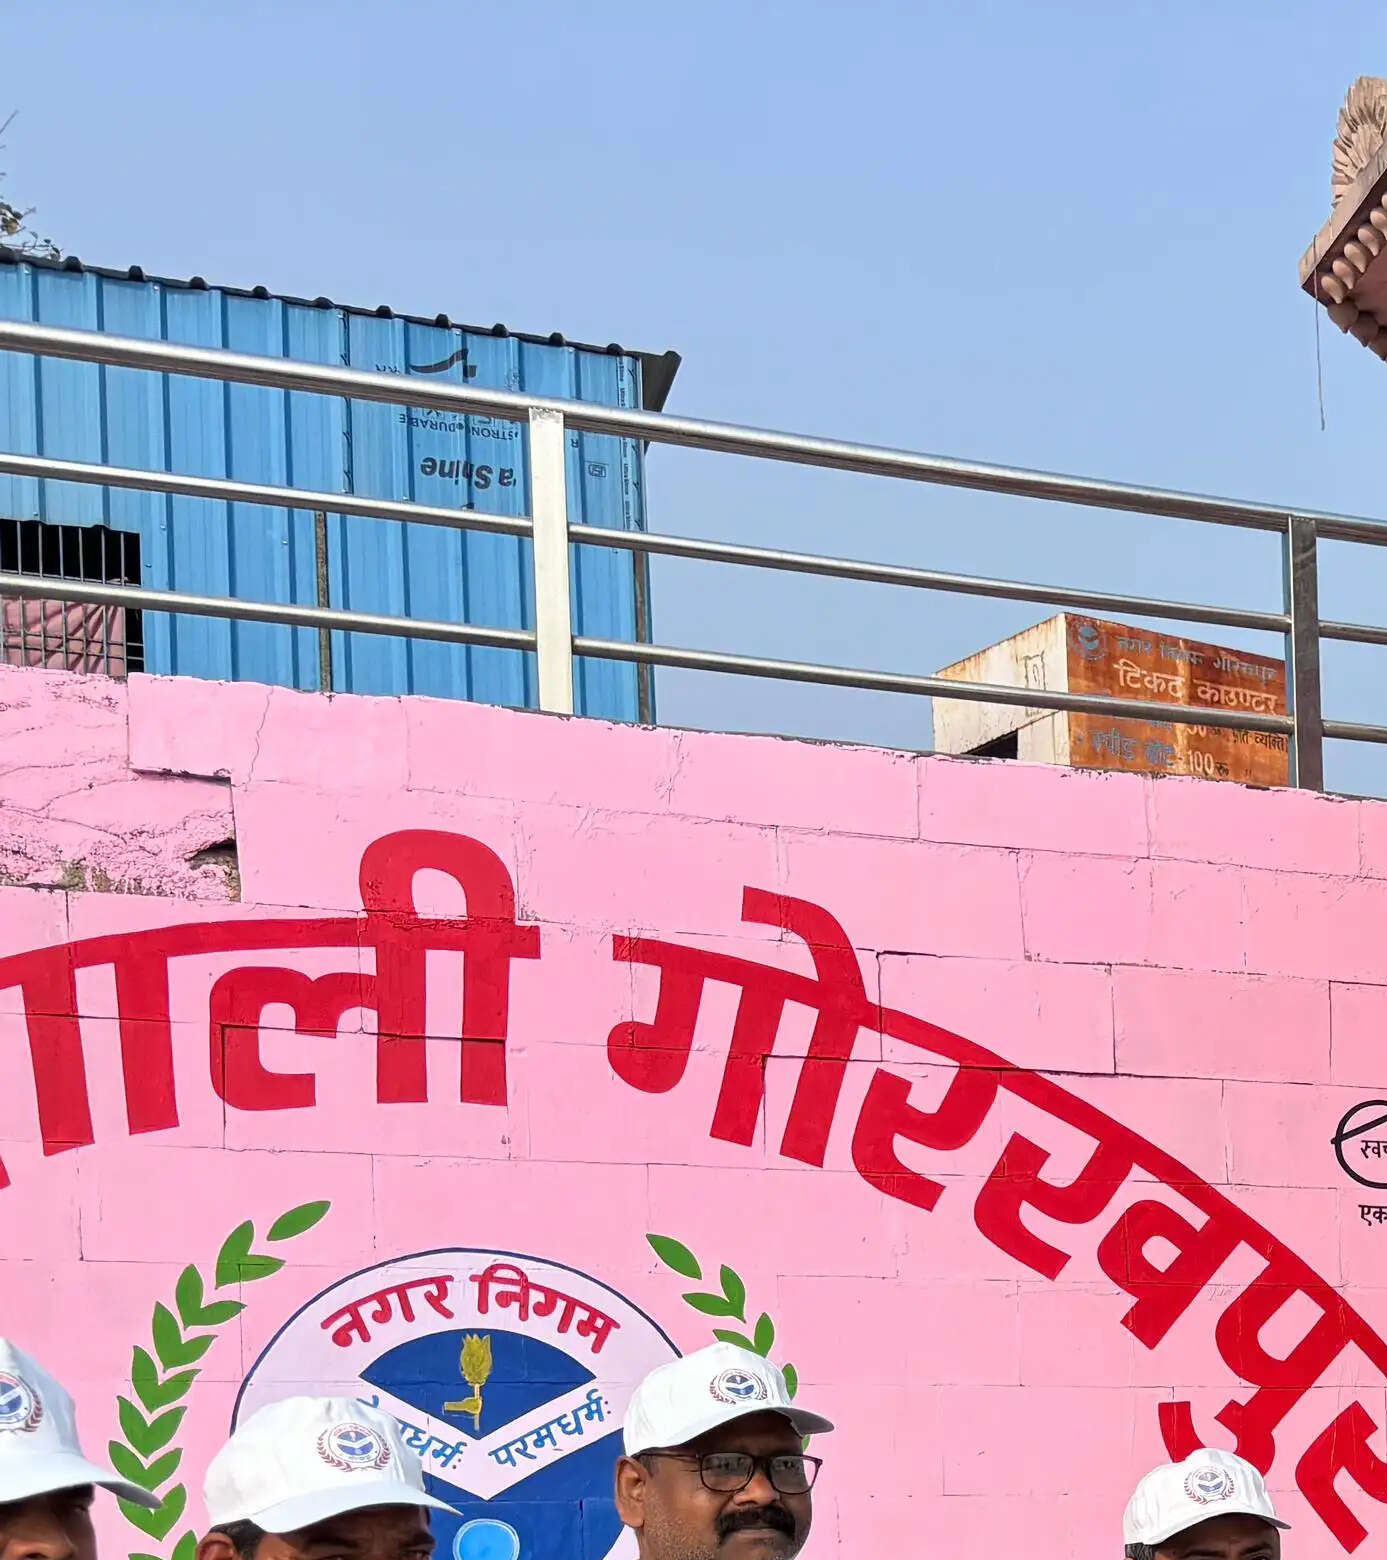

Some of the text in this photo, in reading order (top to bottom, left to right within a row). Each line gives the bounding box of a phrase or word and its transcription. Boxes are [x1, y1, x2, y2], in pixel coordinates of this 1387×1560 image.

[1187, 750, 1215, 775] 100
[321, 1263, 621, 1354] नगर निगम
